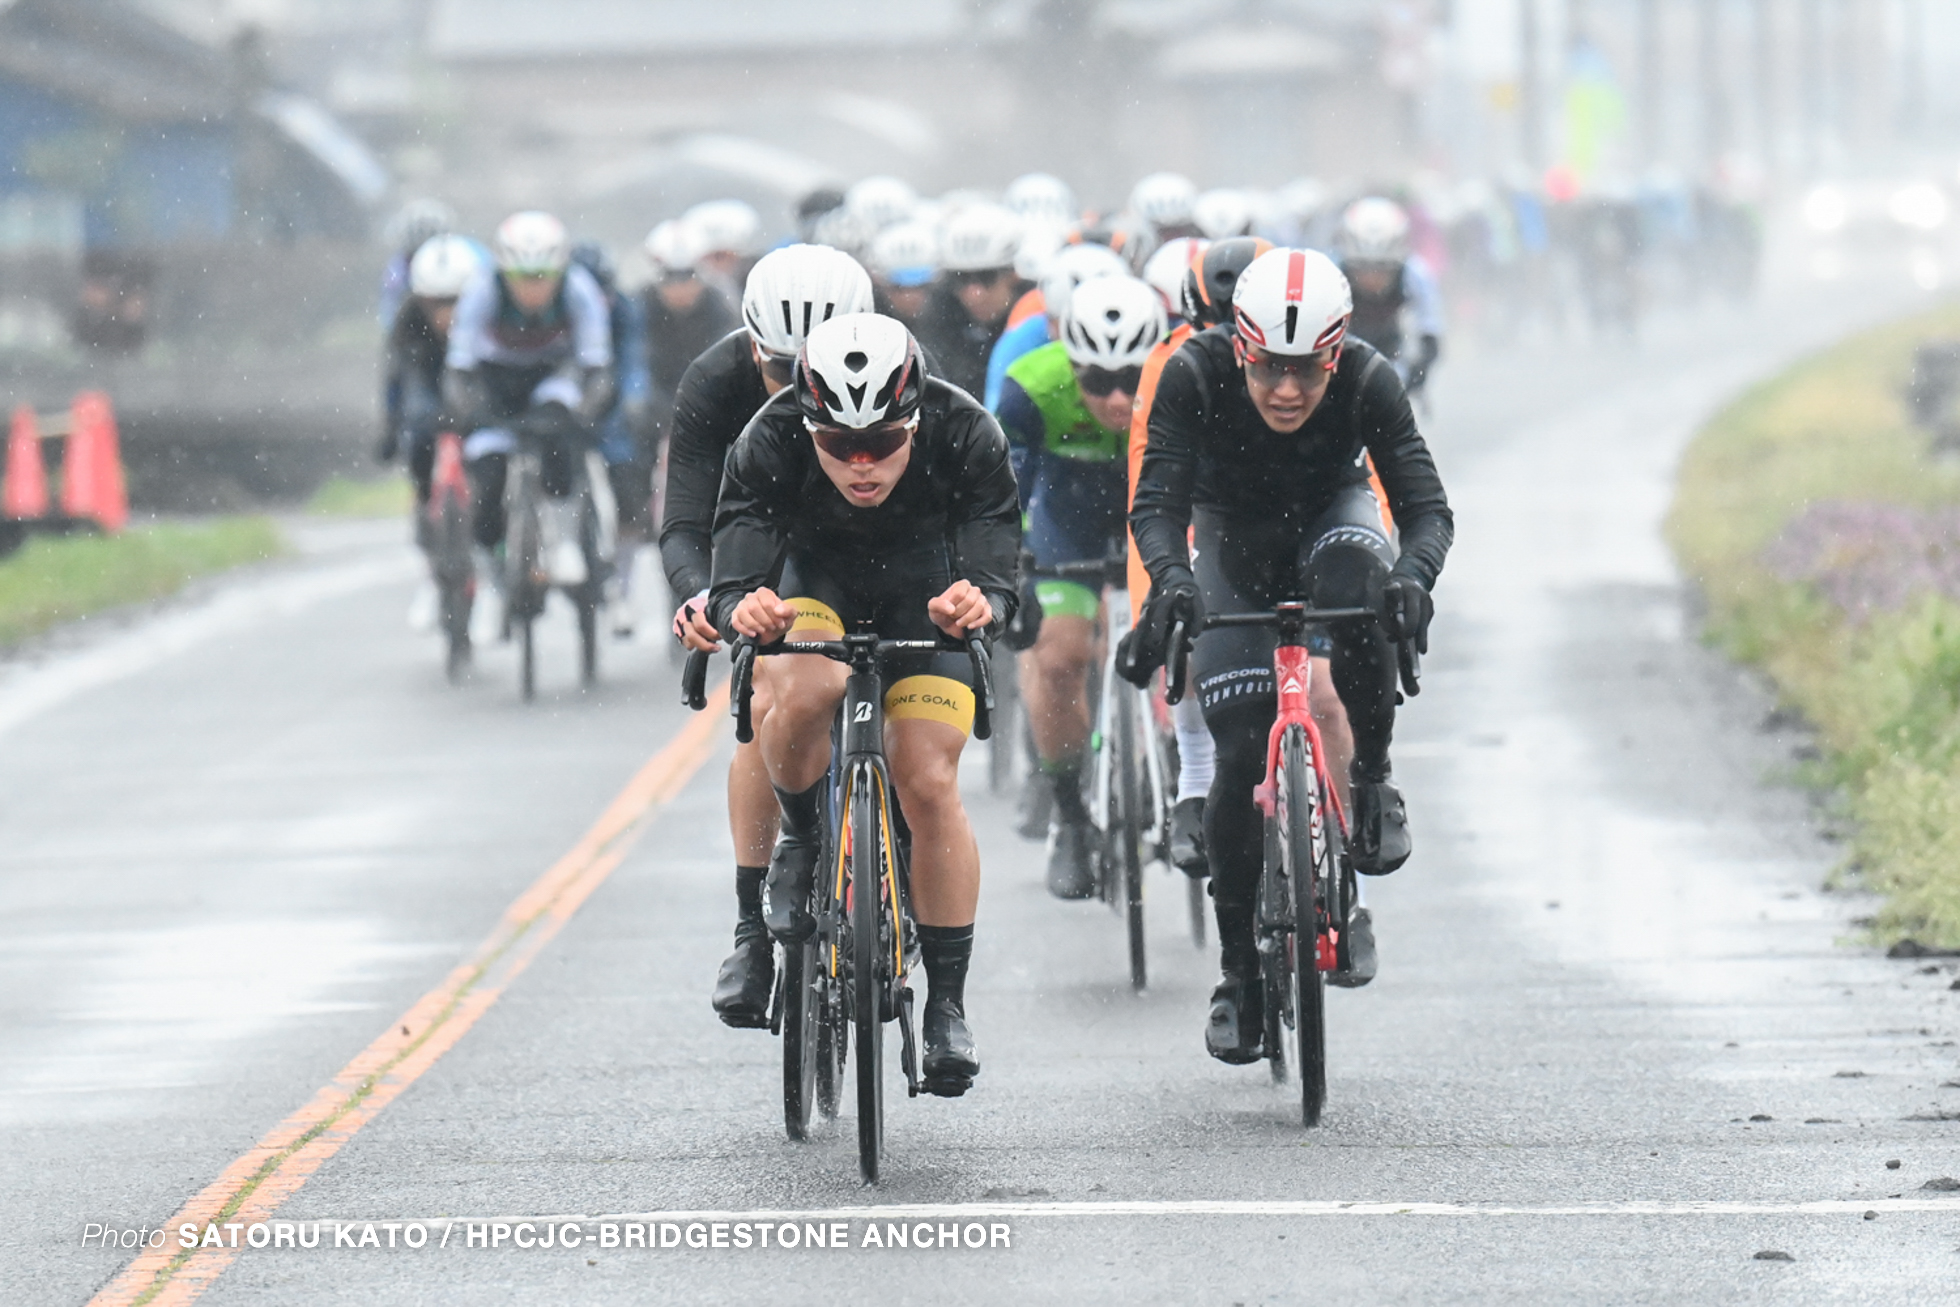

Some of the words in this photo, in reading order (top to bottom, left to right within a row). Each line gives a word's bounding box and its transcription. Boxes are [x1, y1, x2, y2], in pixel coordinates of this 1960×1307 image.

[1200, 668, 1270, 690] VRECORD
[892, 693, 917, 707] ONE
[921, 694, 959, 711] GOAL
[1205, 681, 1272, 708] SUNVOLT
